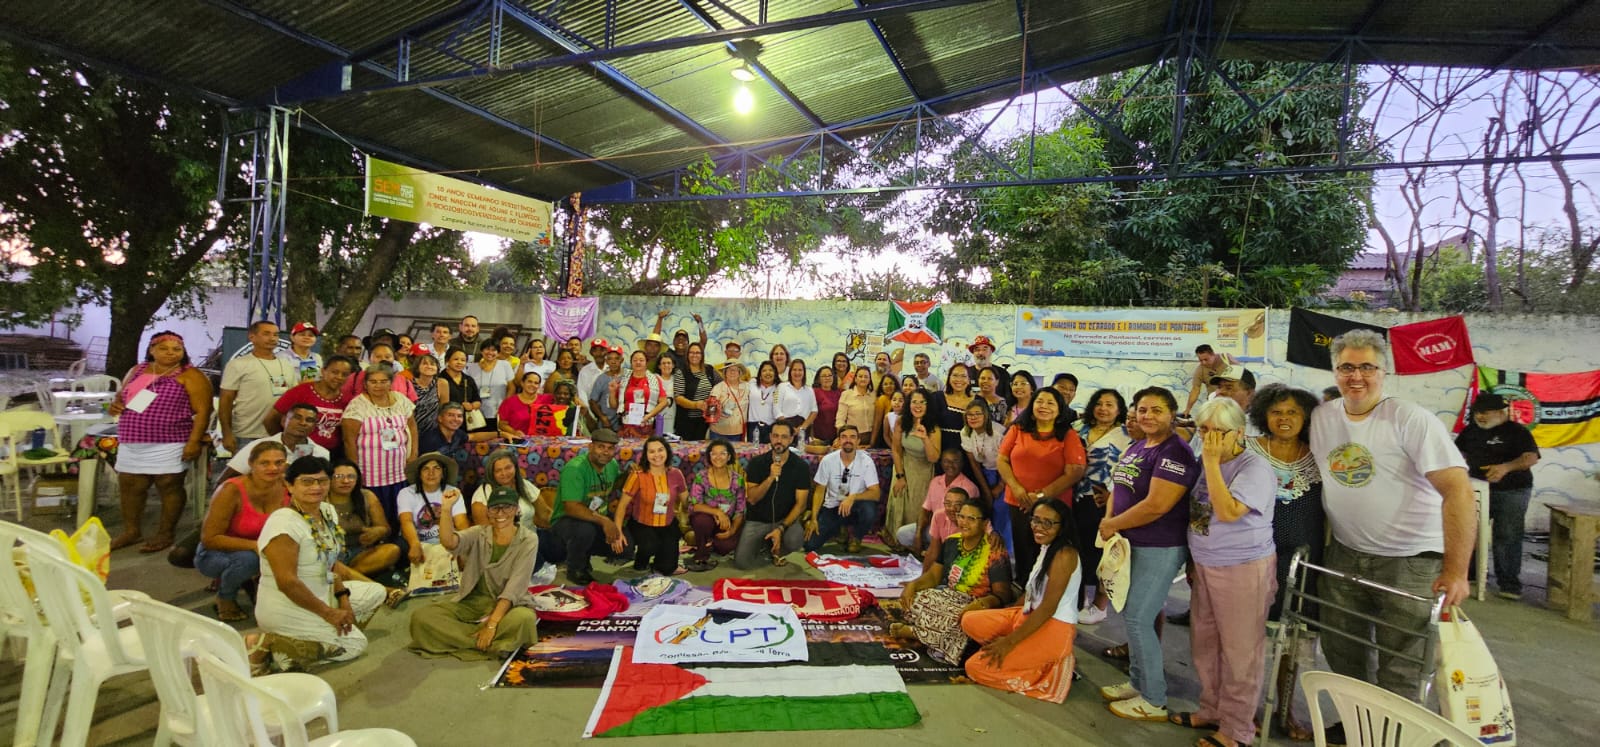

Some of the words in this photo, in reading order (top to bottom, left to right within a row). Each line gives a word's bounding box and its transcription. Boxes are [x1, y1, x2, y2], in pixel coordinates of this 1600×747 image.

[1418, 341, 1453, 356] MAM
[725, 584, 850, 611] CUT
[700, 627, 777, 644] CPT
[829, 624, 882, 632] FRUTOS
[889, 652, 914, 660] CPT
